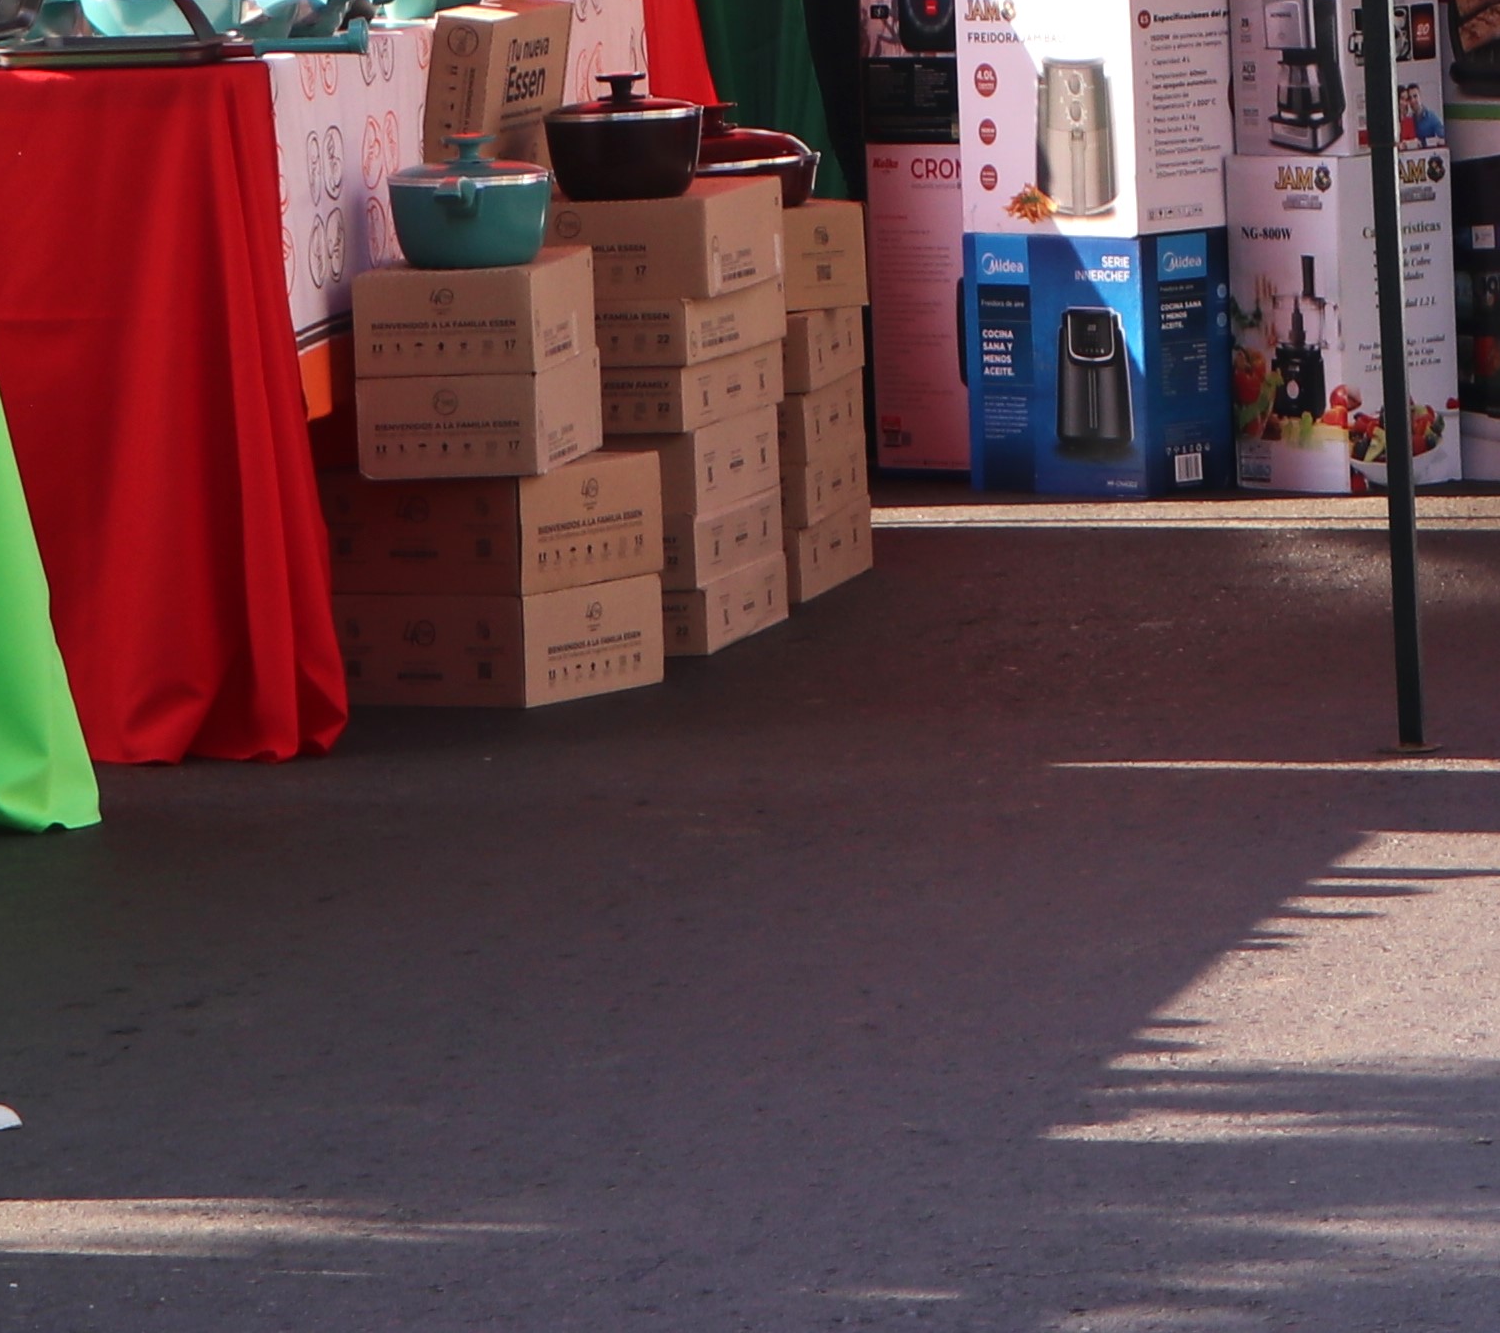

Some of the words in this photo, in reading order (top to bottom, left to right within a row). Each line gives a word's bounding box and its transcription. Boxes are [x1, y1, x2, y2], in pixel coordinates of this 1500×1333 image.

[1153, 11, 1209, 23] Especificaciones
[967, 32, 1019, 44] FREIDORA
[523, 37, 549, 58] nueva
[976, 70, 995, 81] 4.0L
[506, 66, 545, 103] Essen
[1399, 159, 1427, 184] AM
[1274, 164, 1314, 191] JAM
[1241, 226, 1292, 240] NG-800W
[592, 244, 616, 253] MILIA
[617, 244, 647, 252] ESSEN
[982, 254, 1024, 274] Midea
[1101, 256, 1130, 268] SERIE
[1164, 253, 1202, 271] Midea
[635, 266, 647, 275] 17
[1074, 270, 1130, 282] INNERCHEF
[981, 299, 1005, 307] Freidora
[1160, 302, 1184, 311] COCINA
[1184, 300, 1202, 308] SANA
[603, 313, 639, 321] FAMILIA
[641, 312, 670, 320] ESSEN
[1166, 310, 1188, 319] MENOS
[371, 321, 429, 331] BIENVENIDOS
[452, 320, 487, 328] FAMILIA
[489, 319, 516, 327] ESSEN
[1161, 321, 1184, 330] ACEITE.
[657, 334, 670, 344] 22
[982, 329, 1014, 339] COCINA
[504, 339, 516, 350] 17
[982, 342, 1006, 351] SANA
[1007, 342, 1013, 351] Y
[983, 354, 1012, 363] MENOS
[983, 367, 1015, 376] ACEITE.
[635, 381, 669, 389] FAMILY
[375, 422, 433, 431] BIENVENIDOS
[456, 421, 491, 429] FAMILIA
[492, 420, 520, 428] ESSEN
[508, 440, 520, 450] 17
[538, 521, 580, 535] BIENVENIDOS
[582, 519, 588, 527] A
[588, 518, 596, 527] LA
[596, 513, 622, 524] FAMILIA
[623, 510, 643, 520] ESSEN
[634, 534, 643, 546] 15
[548, 643, 586, 655] BIENVENIDOS
[591, 638, 599, 647] LA
[600, 633, 623, 645] FAMILIA
[623, 631, 641, 641] ESSEN
